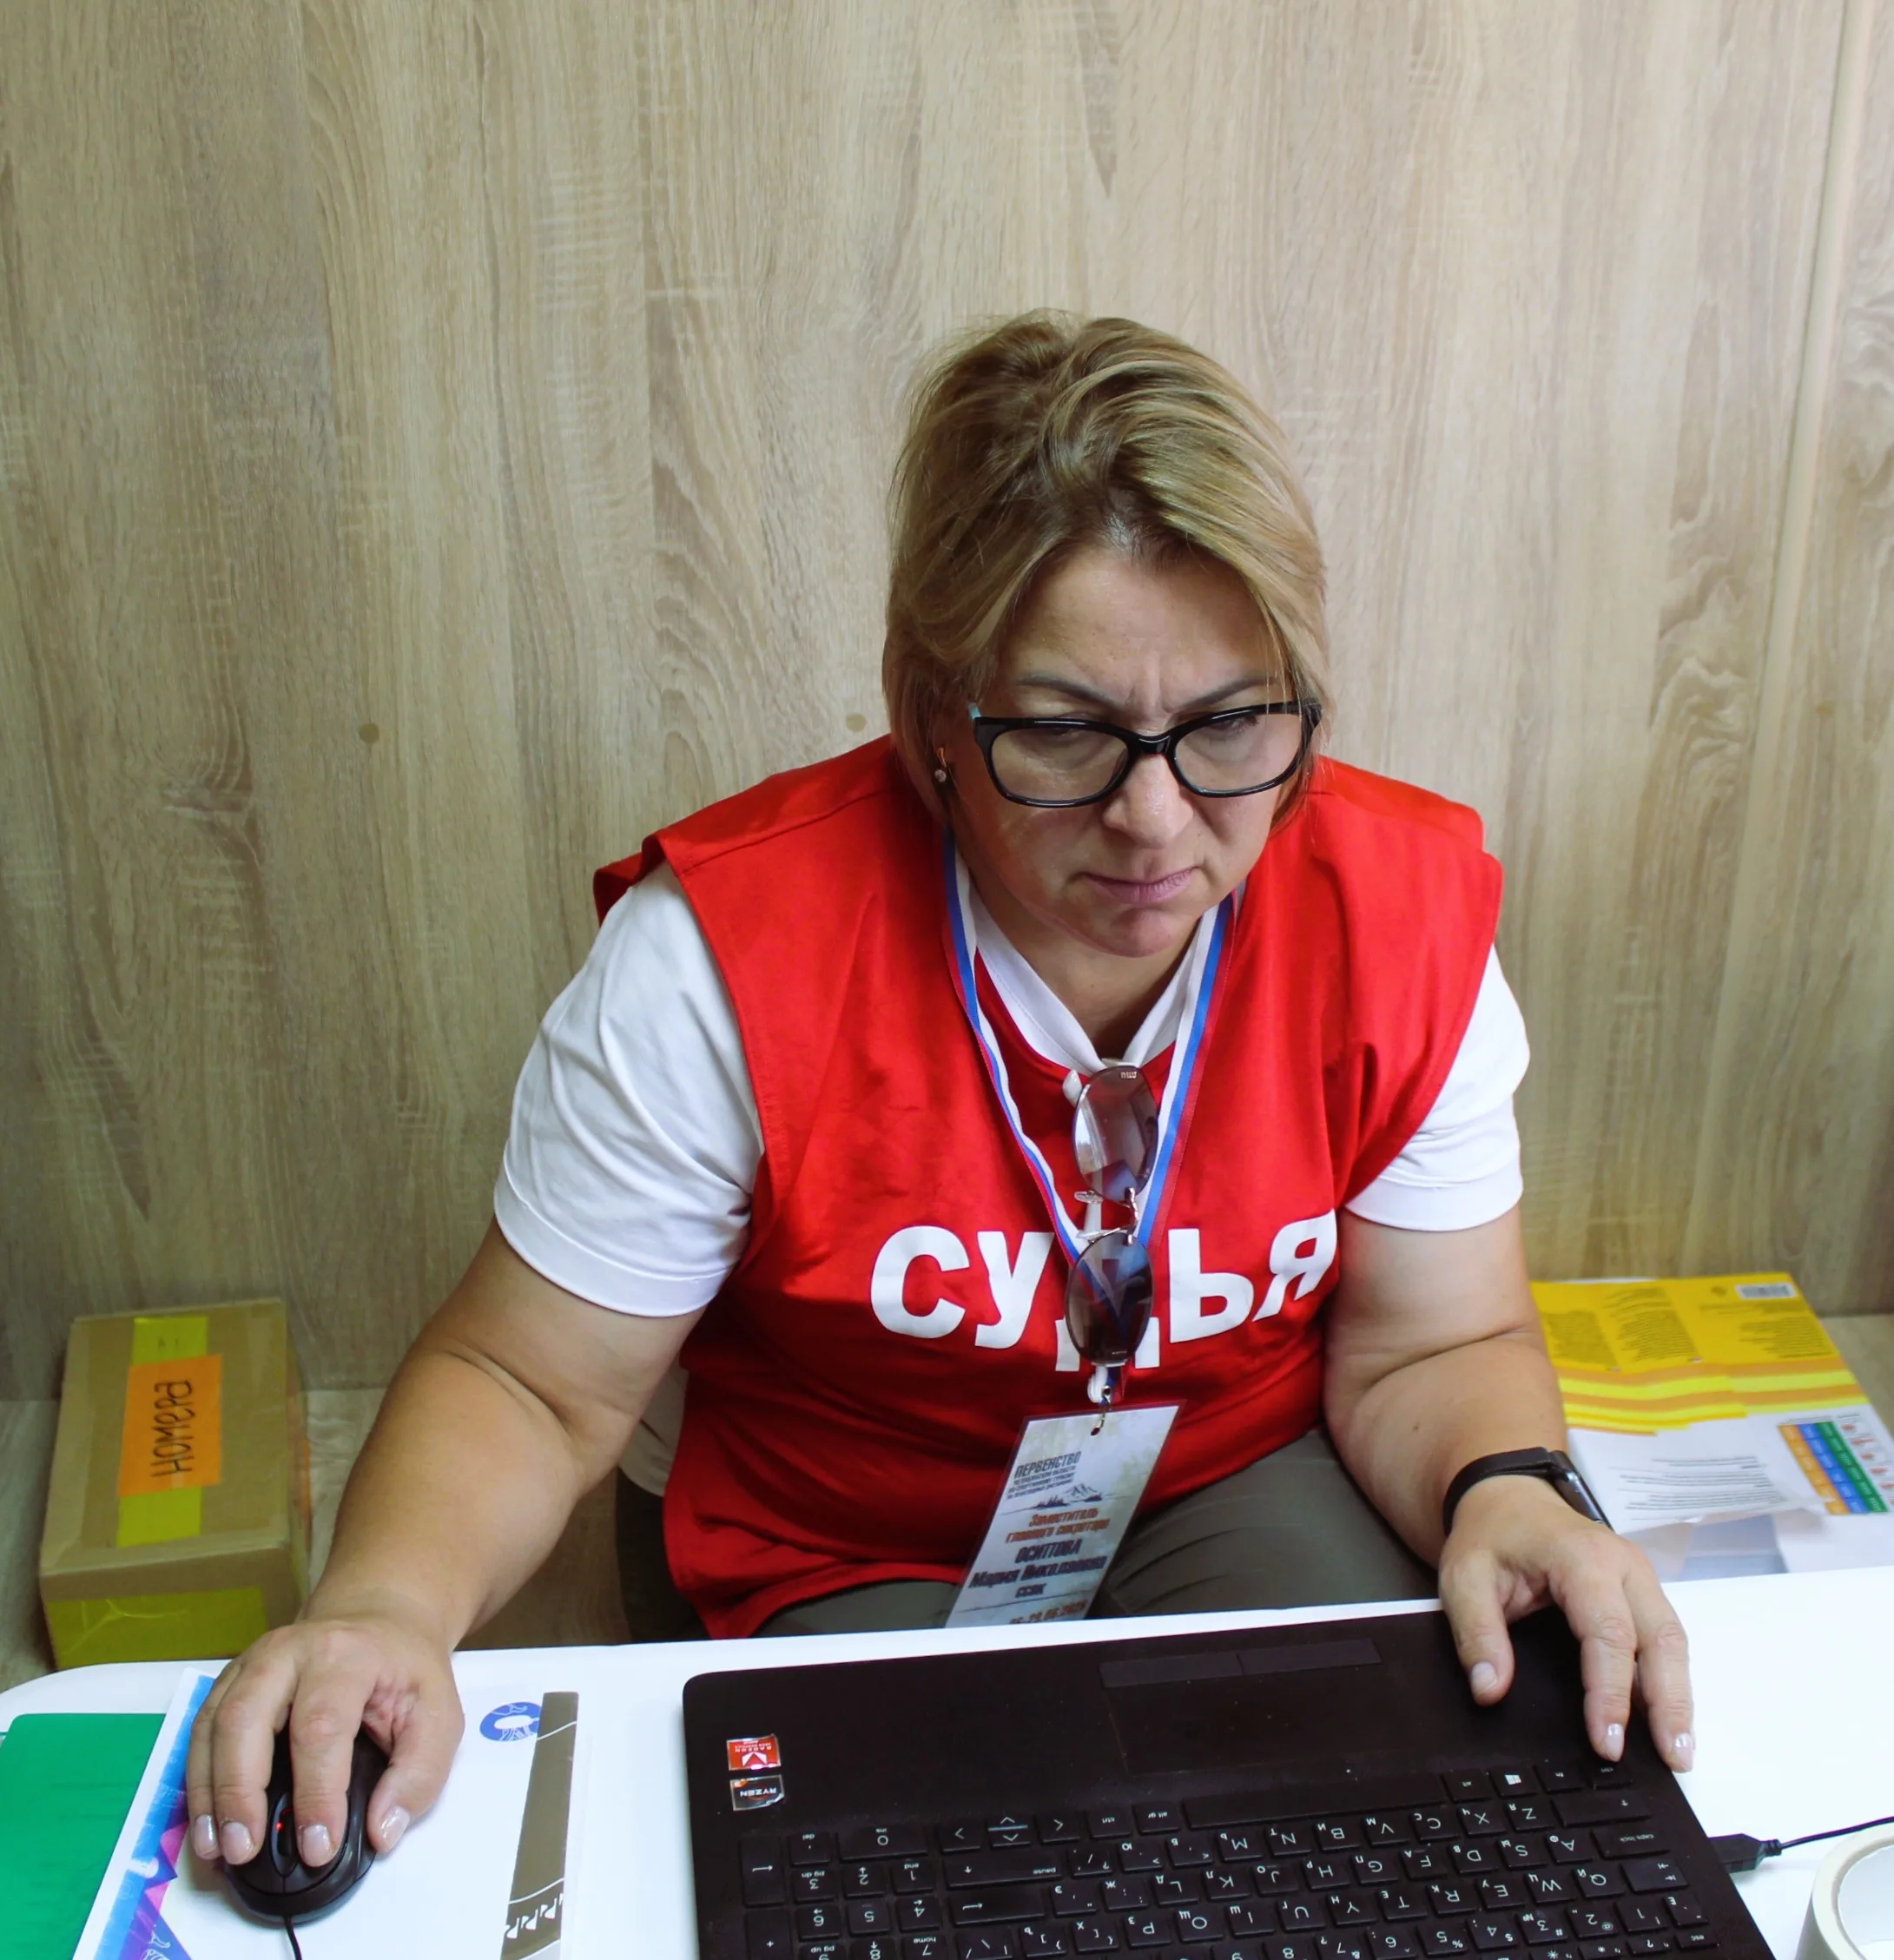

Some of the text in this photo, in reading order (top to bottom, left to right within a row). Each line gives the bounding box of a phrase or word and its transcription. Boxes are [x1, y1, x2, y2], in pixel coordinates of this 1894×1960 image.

[1014, 1451, 1082, 1479] ПЕРВЕНСТВО
[739, 1787, 777, 1798] RYZEN
[1474, 1812, 1490, 1825] X
[1521, 1807, 1537, 1820] Z
[1380, 1822, 1395, 1835] V
[1426, 1817, 1442, 1830] C
[1280, 1832, 1297, 1845] N
[1330, 1827, 1346, 1840] B
[1231, 1838, 1249, 1851] M
[1515, 1845, 1528, 1857] S
[1561, 1839, 1574, 1851] A
[1420, 1855, 1432, 1868] F
[1466, 1849, 1482, 1862] D
[903, 1862, 920, 1871] end
[1033, 1866, 1057, 1875] pause
[1317, 1864, 1334, 1878] H
[1367, 1860, 1383, 1873] G
[859, 1874, 868, 1886] 2
[909, 1870, 916, 1881] 1
[1218, 1875, 1235, 1889] K
[1270, 1870, 1280, 1884] J
[1589, 1873, 1607, 1886] Q
[808, 1878, 819, 1890] 3
[1169, 1880, 1183, 1893] L
[1493, 1884, 1509, 1897] E
[1541, 1878, 1562, 1892] W
[1398, 1896, 1410, 1909] T
[1444, 1889, 1461, 1903] R
[914, 1907, 925, 1917] 4
[1294, 1905, 1310, 1919] U
[1346, 1901, 1360, 1914] Y
[814, 1916, 824, 1927] 6
[863, 1911, 874, 1923] 5
[1585, 1913, 1598, 1925] 2
[1142, 1921, 1156, 1935] P
[1486, 1925, 1497, 1937] 4
[1536, 1919, 1549, 1931] 3
[1384, 1936, 1397, 1949] 6
[1435, 1930, 1448, 1944] 5
[869, 1949, 881, 1960] 8
[922, 1944, 932, 1956] 7
[1282, 1947, 1295, 1960] 8
[1336, 1942, 1347, 1955] 7
